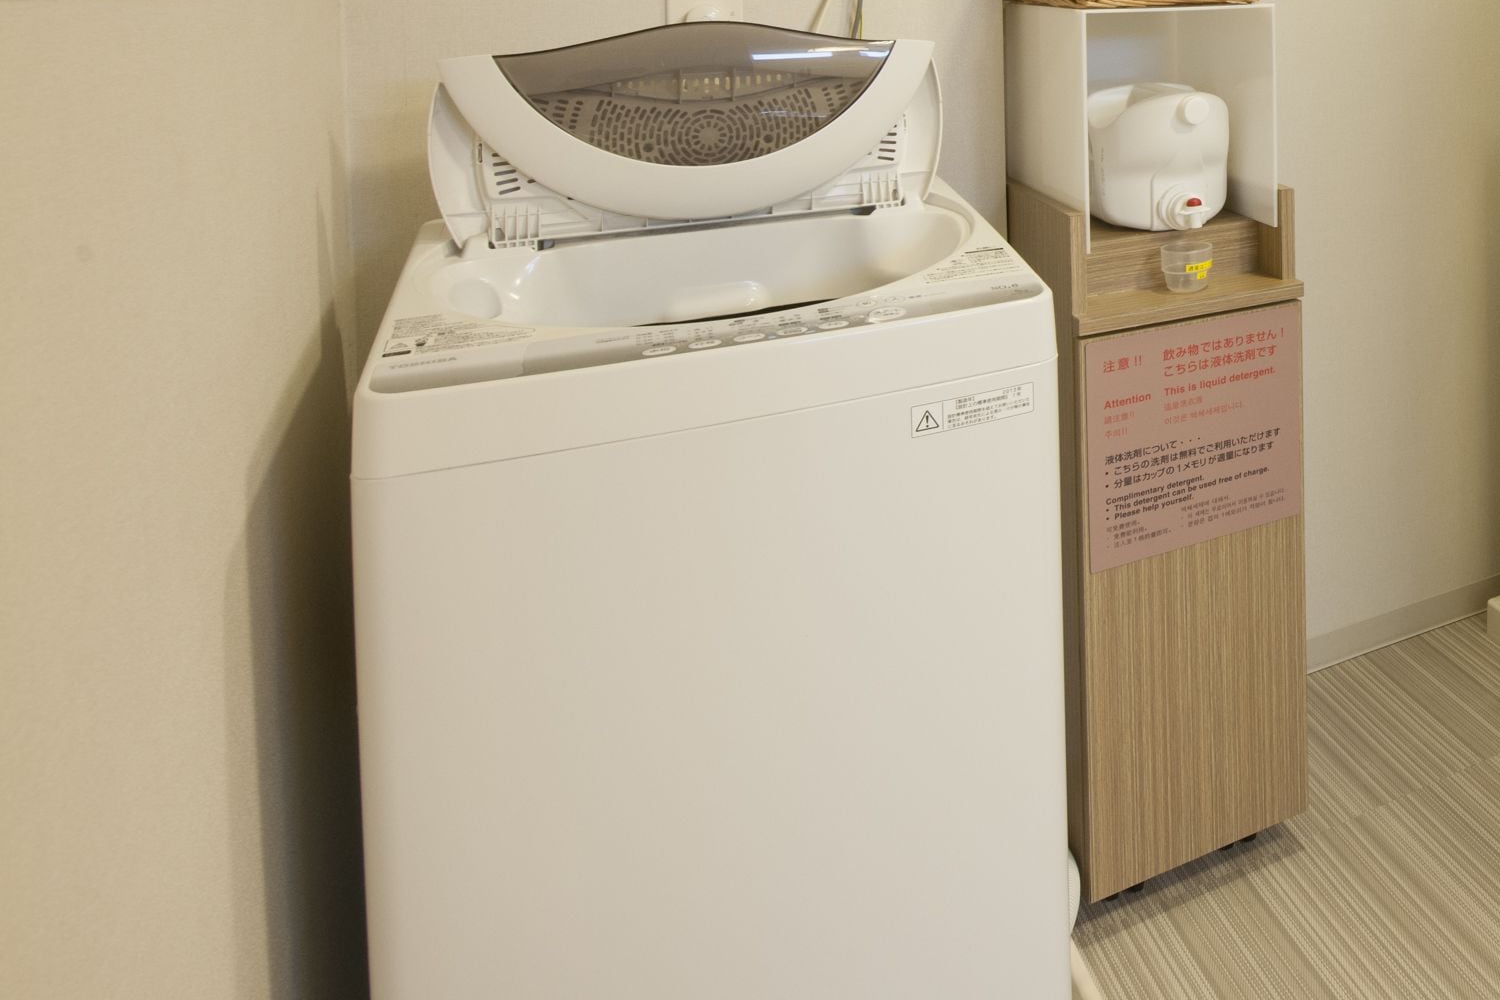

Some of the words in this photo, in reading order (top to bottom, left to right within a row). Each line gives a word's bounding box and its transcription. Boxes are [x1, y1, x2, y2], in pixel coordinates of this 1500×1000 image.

[1164, 344, 1277, 378] こちらは液体洗剤です
[1164, 385, 1184, 396] This
[1188, 382, 1196, 391] is
[1200, 375, 1227, 391] liquid
[1229, 364, 1276, 384] detergent.
[1104, 392, 1151, 409] Attention
[1114, 428, 1280, 475] こちらの洗剤は無料でご利用いただけます
[1106, 485, 1164, 506] Complimentary
[1167, 475, 1204, 490] detergent.
[1115, 502, 1131, 511] This
[1133, 492, 1170, 507] detergent
[1172, 488, 1185, 496] can
[1199, 479, 1216, 489] used
[1219, 475, 1232, 484] free
[1244, 466, 1270, 479] charge.
[1115, 508, 1140, 520] Please
[1143, 503, 1158, 514] help
[1161, 493, 1194, 509] yourself.
